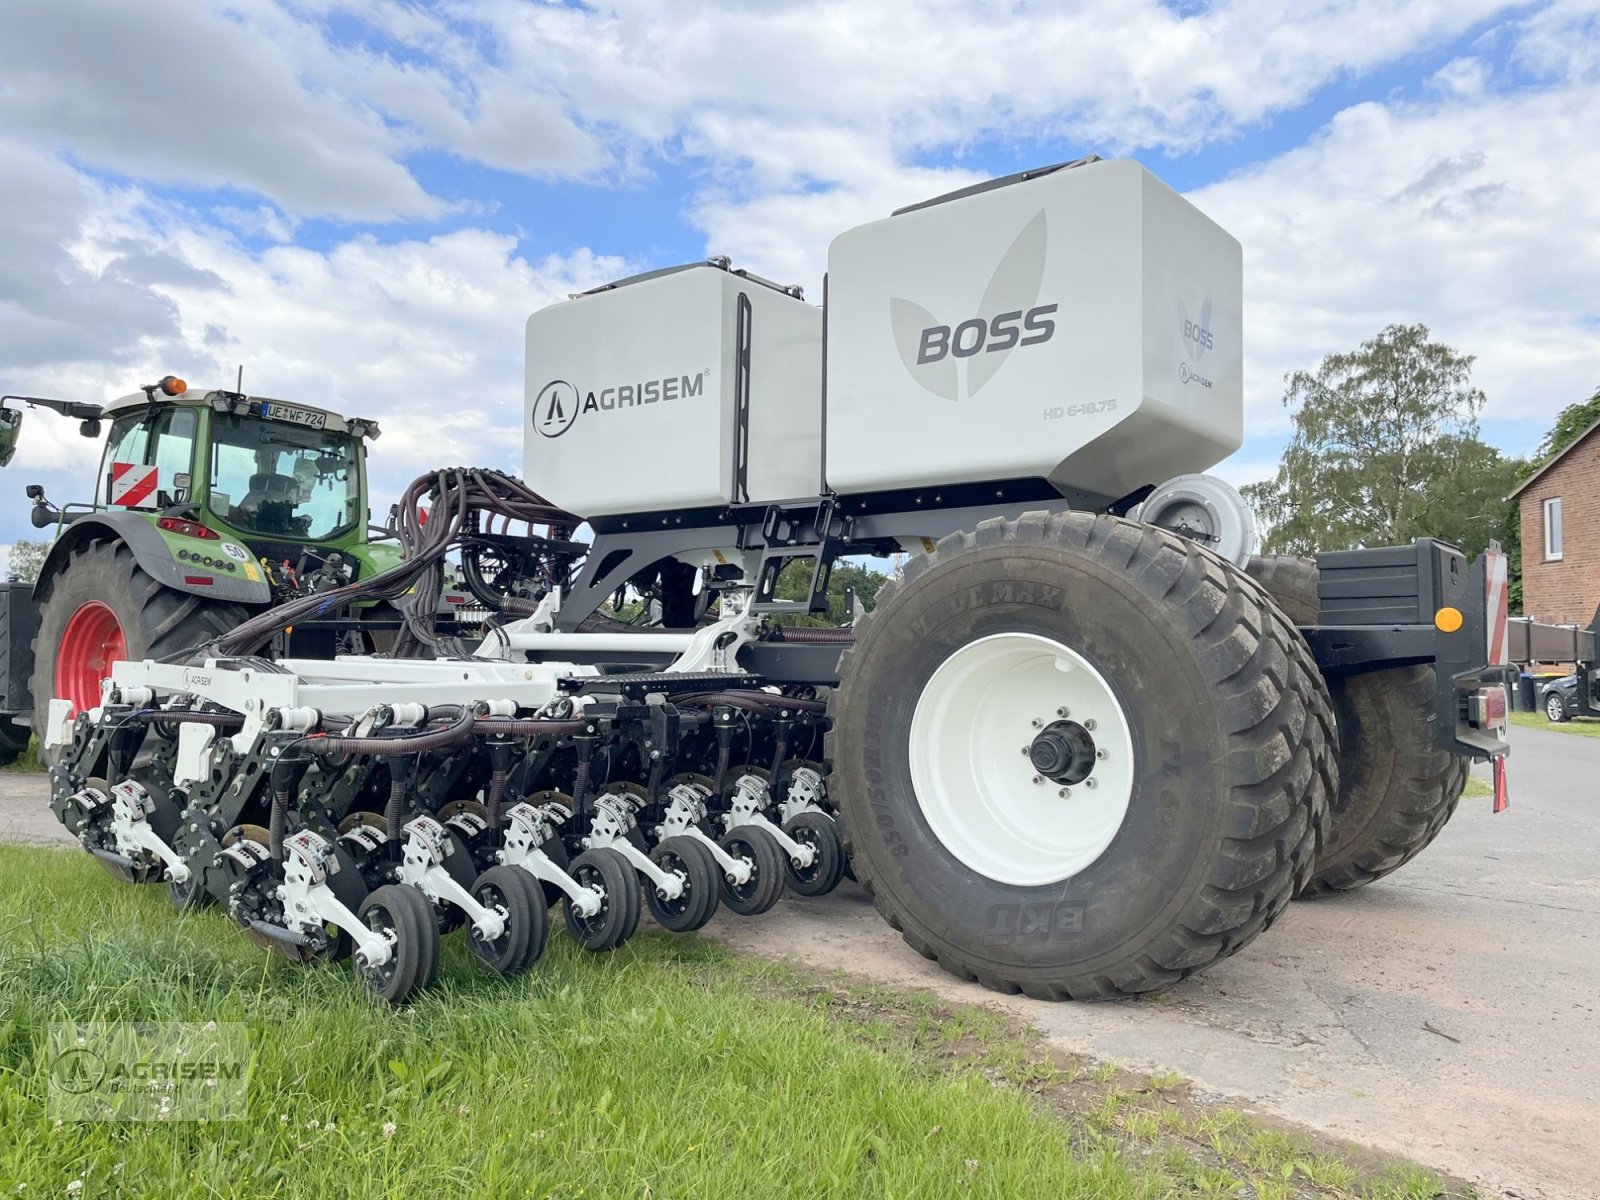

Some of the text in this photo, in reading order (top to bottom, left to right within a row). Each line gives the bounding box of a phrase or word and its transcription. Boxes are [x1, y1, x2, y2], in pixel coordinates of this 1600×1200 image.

[916, 303, 1059, 366] BOSS
[1184, 319, 1214, 351] BOSS
[581, 372, 704, 414] AGRISEM
[304, 413, 323, 427] 724
[1042, 407, 1064, 421] HD
[224, 543, 246, 560] 50
[984, 900, 1087, 945] BKT
